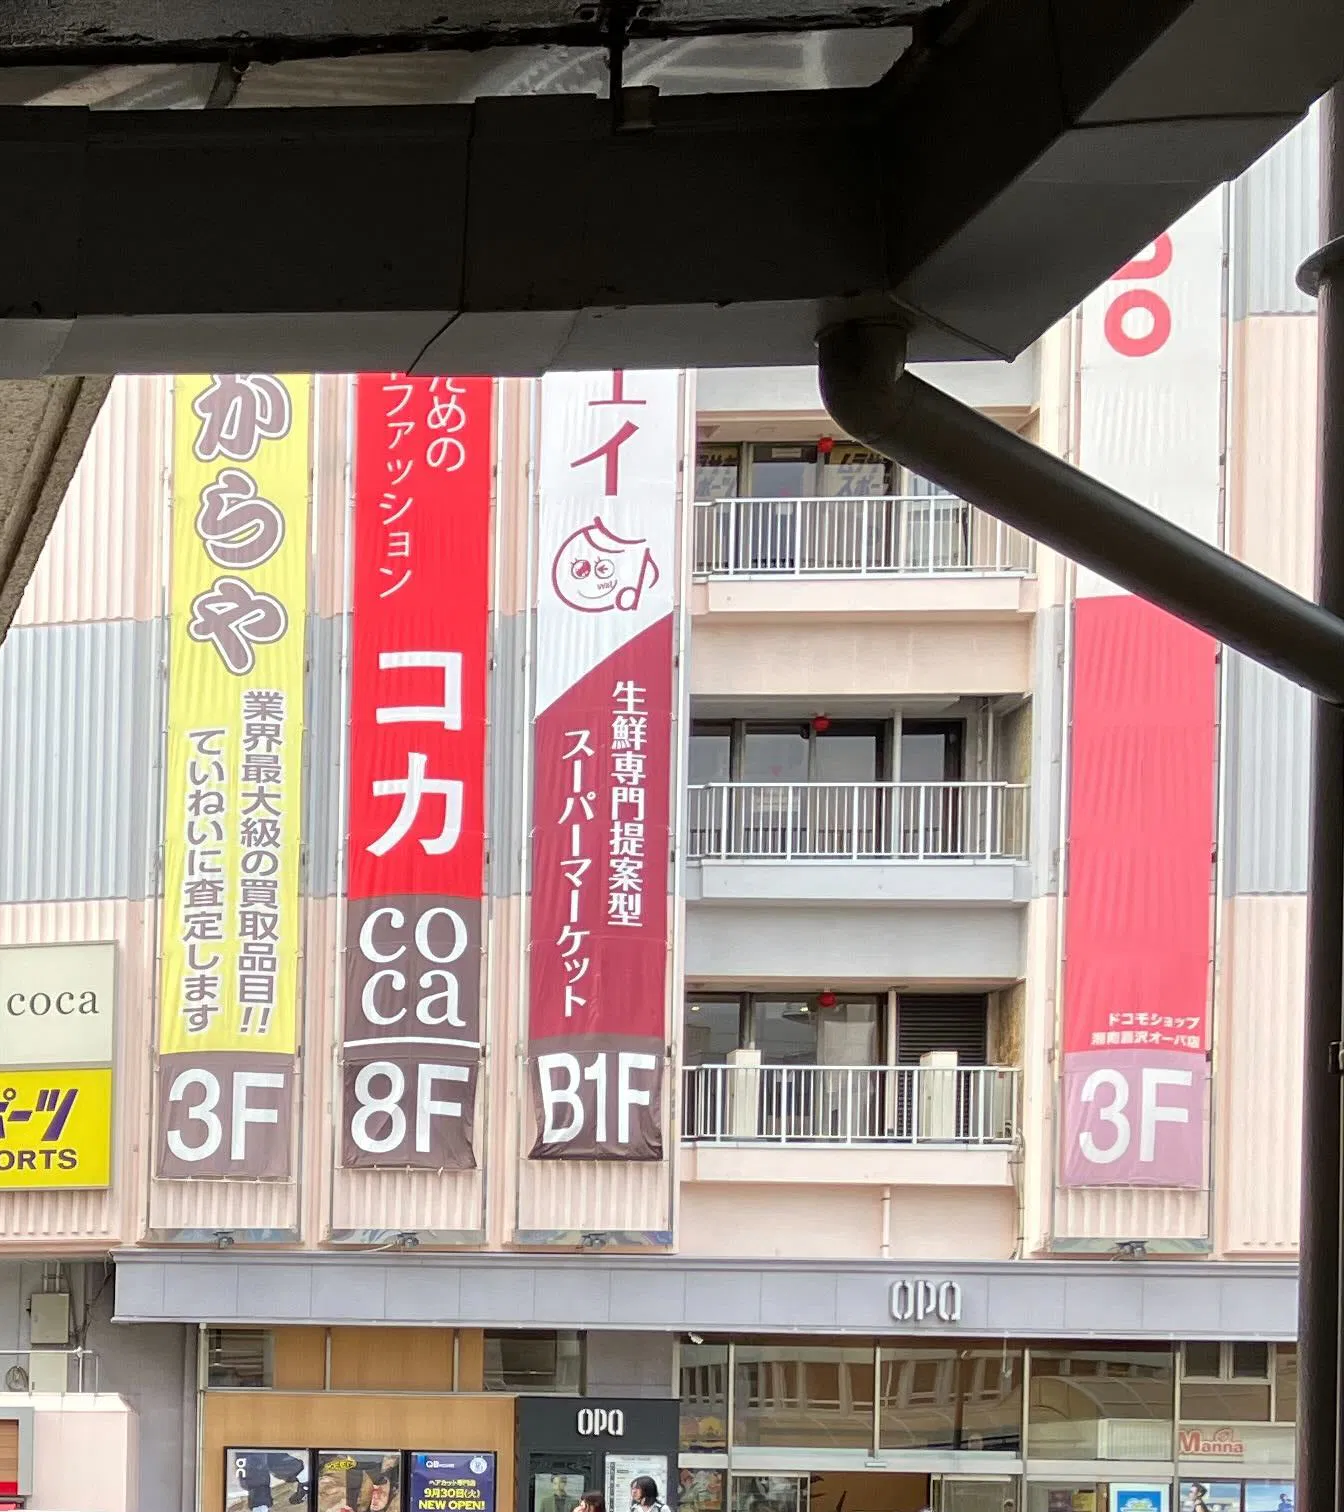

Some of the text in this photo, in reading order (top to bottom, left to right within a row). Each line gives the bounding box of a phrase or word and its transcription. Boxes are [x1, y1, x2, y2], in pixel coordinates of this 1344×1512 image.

[379, 373, 416, 598] ファッション
[366, 650, 464, 859] コカ
[607, 681, 649, 928] 生鮮専門提案型
[183, 729, 226, 1033] ていねいに査定します
[556, 729, 596, 1018] スーパーマーケット
[7, 984, 100, 1016] coca
[167, 1068, 285, 1162] 3F
[350, 1061, 470, 1154] 8F
[538, 1053, 656, 1145] B1F
[1078, 1067, 1194, 1165] 3F
[1179, 1430, 1244, 1454] Manna
[418, 1500, 486, 1511] NEW OPEN!
